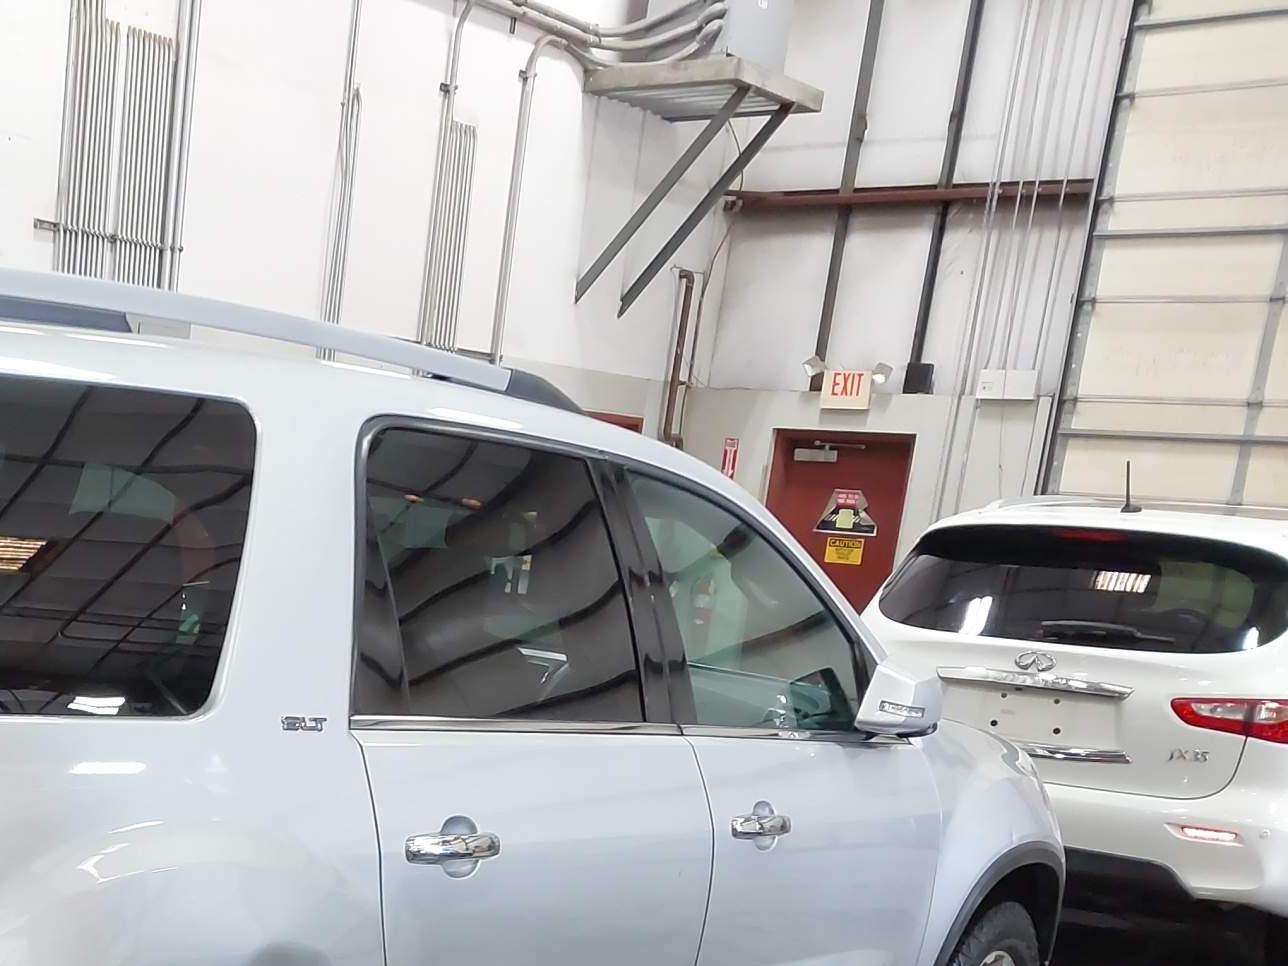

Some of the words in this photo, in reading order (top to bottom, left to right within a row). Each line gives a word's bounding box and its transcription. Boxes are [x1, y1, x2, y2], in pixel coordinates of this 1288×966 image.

[831, 372, 864, 396] EXIT
[830, 539, 861, 548] CAUTION
[281, 716, 327, 732] SLT
